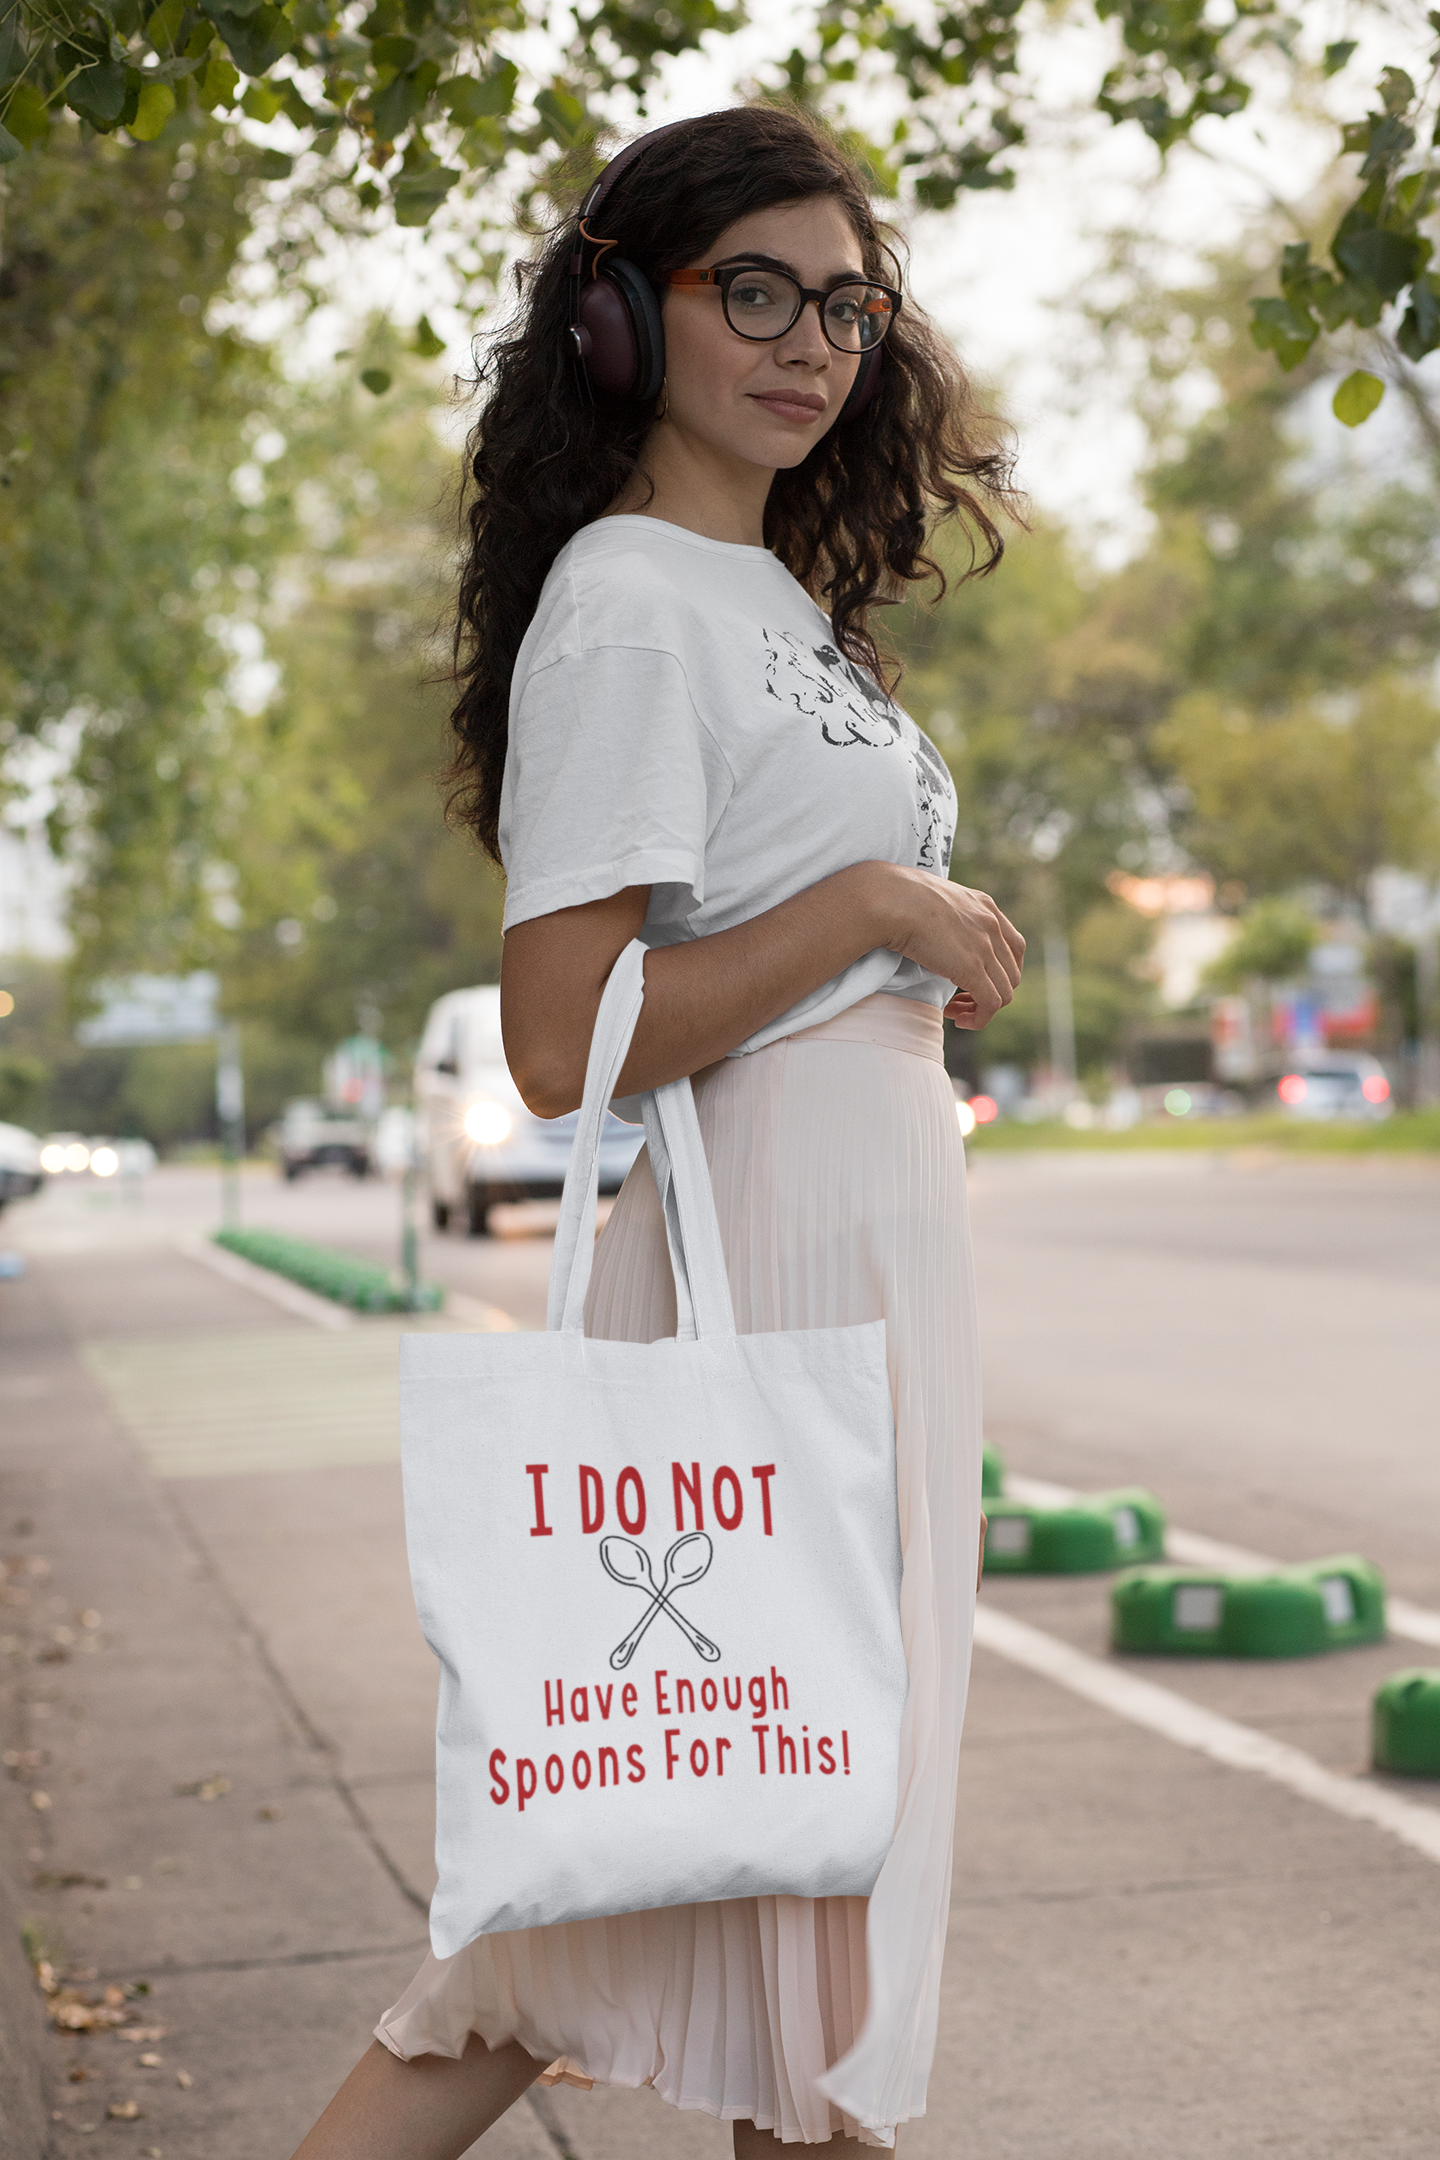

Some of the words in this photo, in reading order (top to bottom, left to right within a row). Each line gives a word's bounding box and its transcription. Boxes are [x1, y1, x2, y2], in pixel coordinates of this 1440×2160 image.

[525, 1463, 553, 1537] I
[578, 1464, 647, 1536] DO
[671, 1461, 776, 1537] NOT
[544, 1678, 638, 1727] Have
[654, 1665, 789, 1720] Enough
[488, 1743, 646, 1812] Spoons
[664, 1728, 732, 1780] For
[751, 1724, 851, 1776] This!
